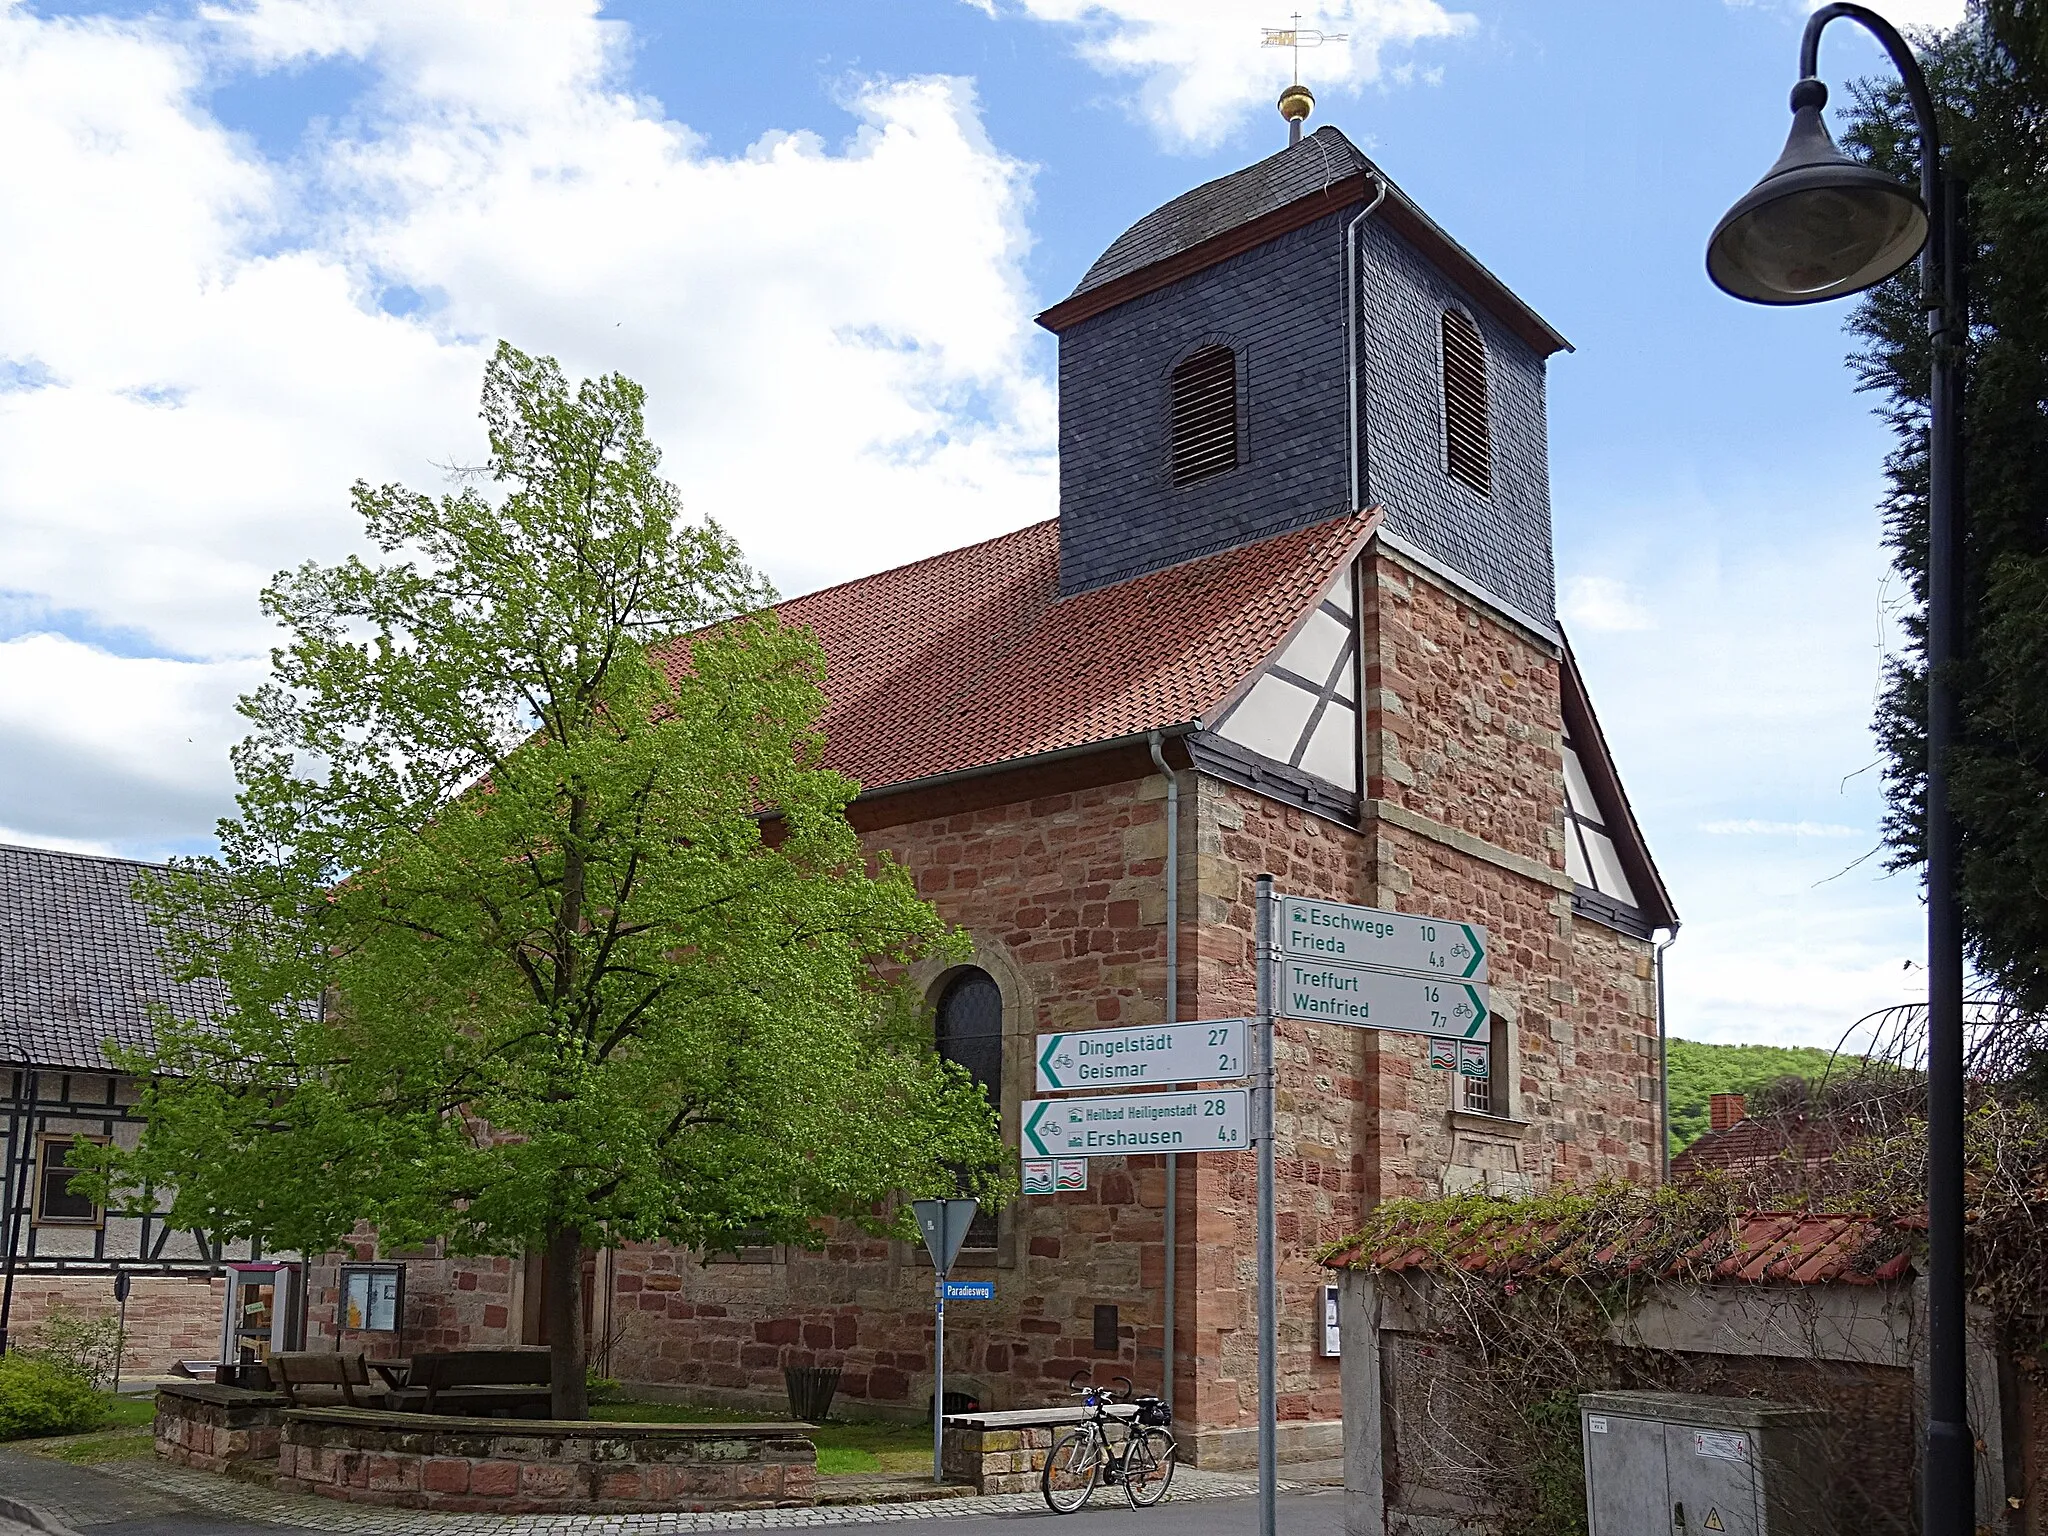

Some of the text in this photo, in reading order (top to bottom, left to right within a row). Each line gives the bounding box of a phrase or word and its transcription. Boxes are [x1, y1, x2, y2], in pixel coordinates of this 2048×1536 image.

[1311, 909, 1436, 942] Eschwege 10
[1291, 931, 1345, 954] Frieda
[1293, 968, 1439, 1002] Treffurt 16
[1293, 994, 1368, 1018] Wanfried
[1079, 1029, 1228, 1057] Dingelstädt 27
[1079, 1063, 1147, 1079] Geismar
[1086, 1099, 1225, 1121] Heilbad Heiligenstadt 28
[1087, 1130, 1182, 1147] Ershausen
[947, 1285, 989, 1298] Paradiesweg
